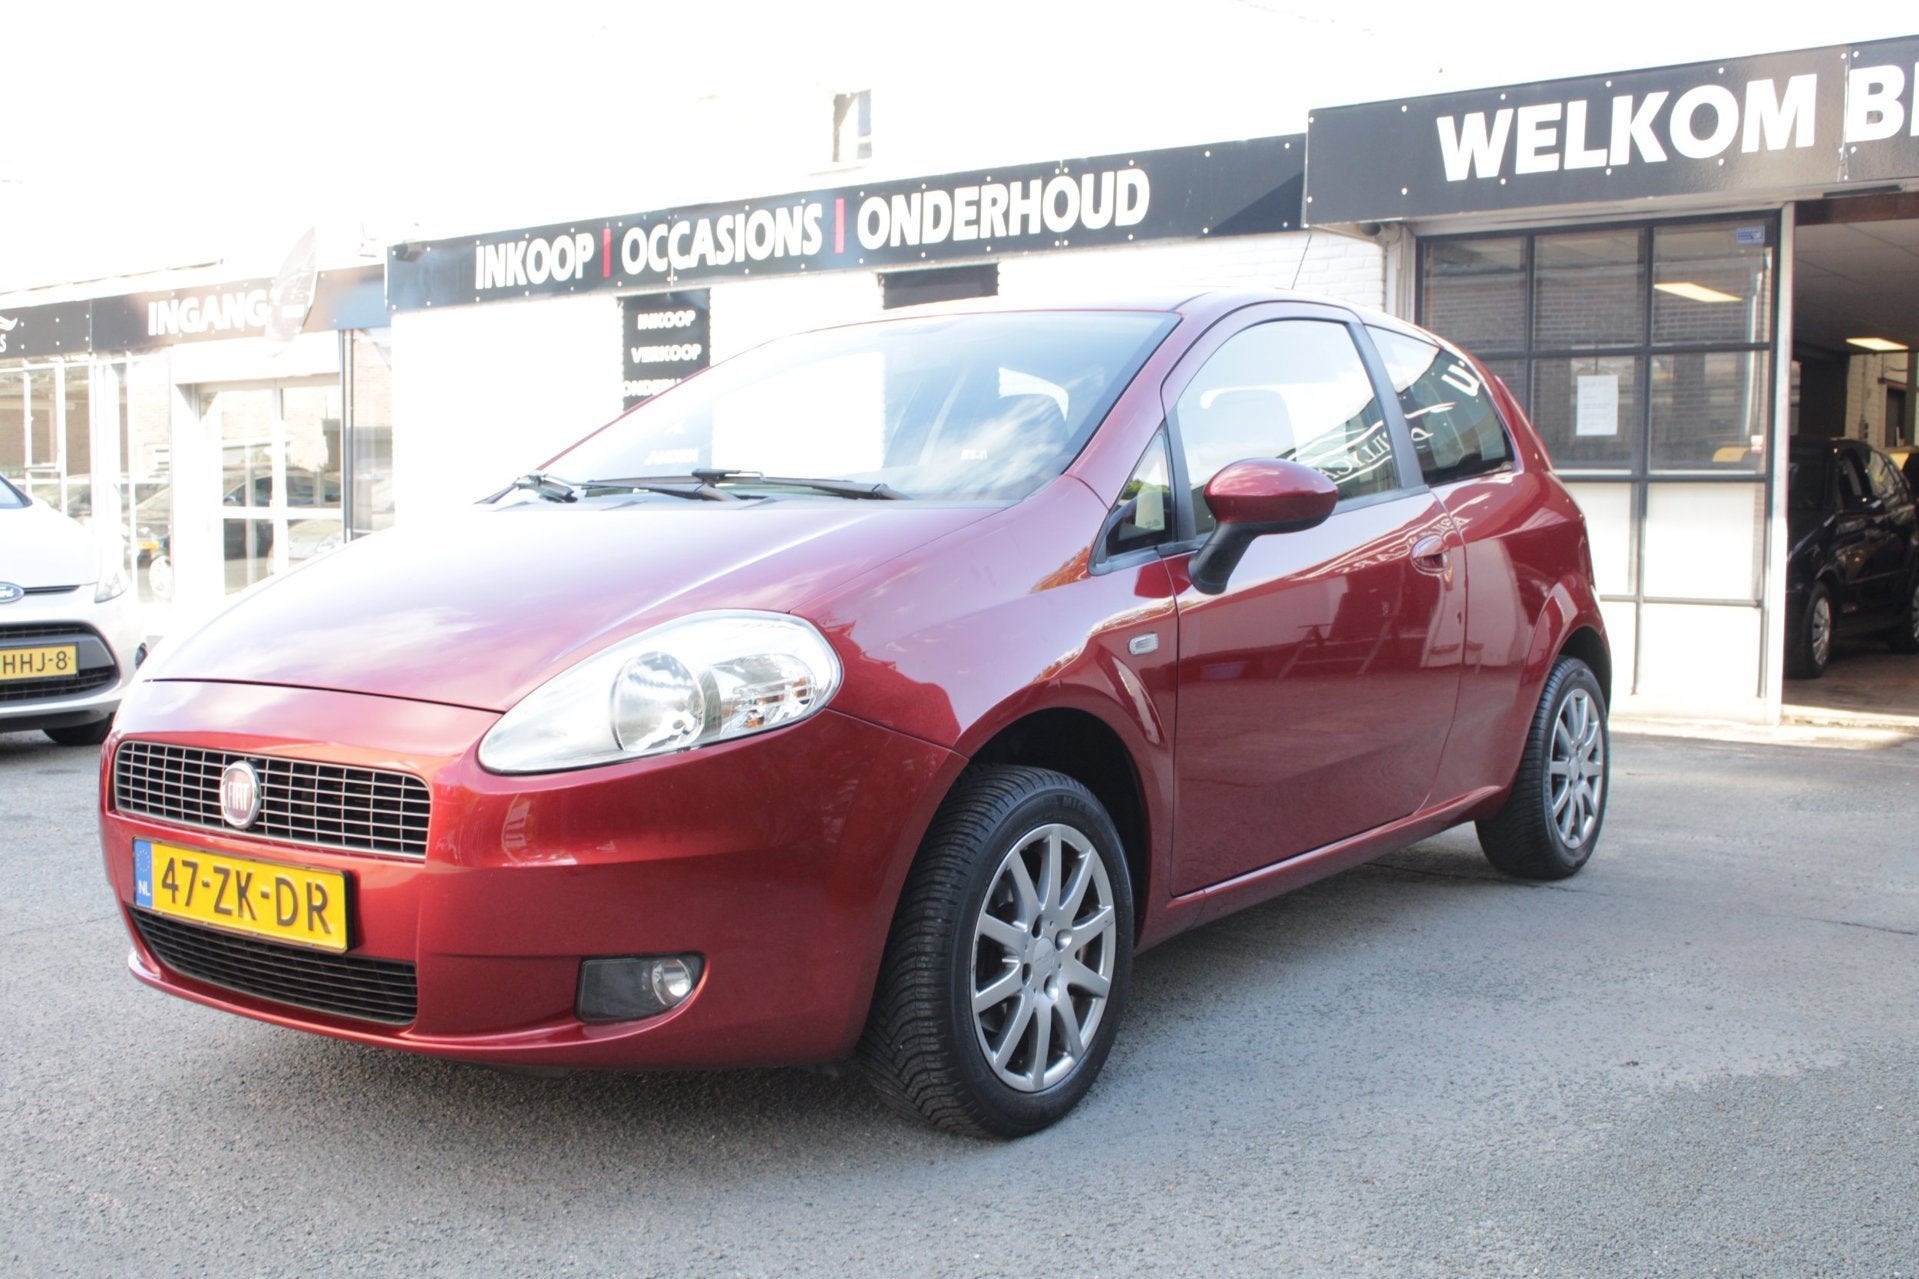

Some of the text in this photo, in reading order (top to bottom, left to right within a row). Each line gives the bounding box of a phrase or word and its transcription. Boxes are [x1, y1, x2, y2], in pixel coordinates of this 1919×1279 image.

[1436, 73, 1818, 182] WELKOM
[475, 168, 1150, 289] INKOOP OCCASIONS ONDERHOUD
[148, 289, 269, 336] INGANG
[637, 309, 696, 330] INKOOP
[630, 343, 702, 364] VERKOOP
[228, 781, 250, 811] FIAT
[138, 878, 151, 897] NL
[161, 857, 332, 934] 47-ZK-DR
